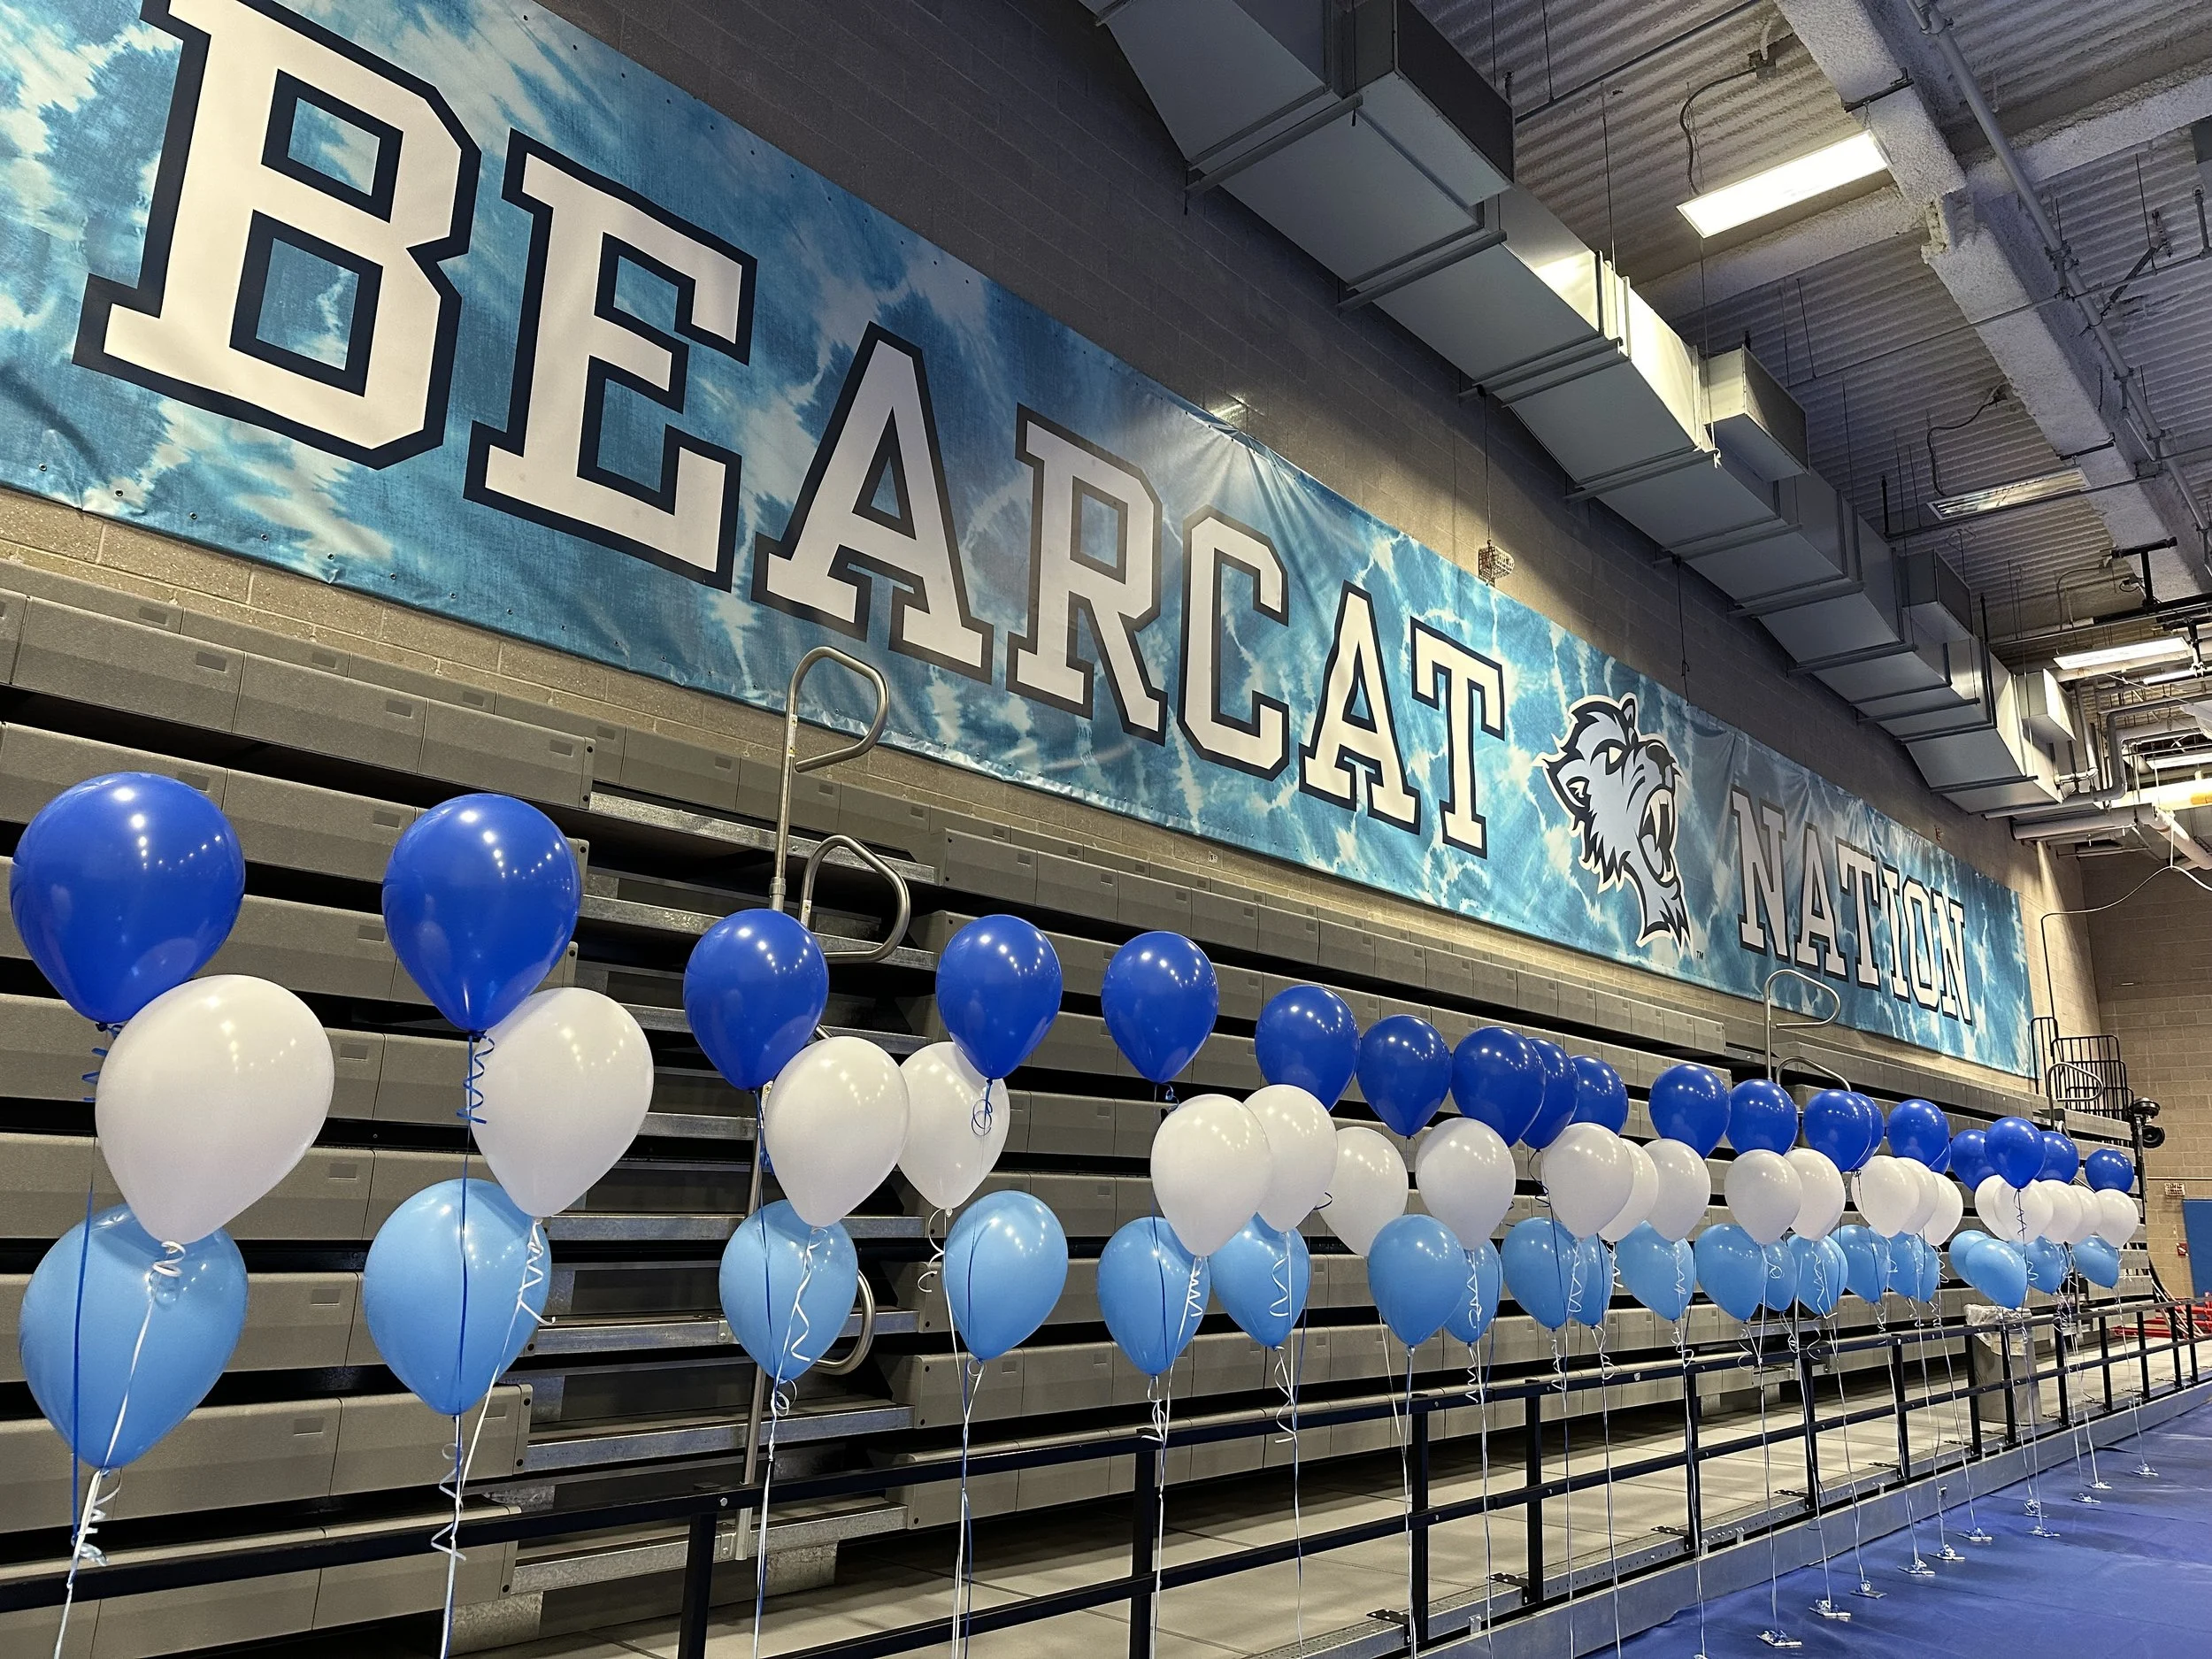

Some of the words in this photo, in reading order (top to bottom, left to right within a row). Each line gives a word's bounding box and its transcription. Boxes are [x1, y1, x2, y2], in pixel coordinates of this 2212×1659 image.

[73, 0, 1505, 859] BEARCAT
[1732, 786, 1973, 1025] NATION
[1695, 949, 1704, 960] TM
